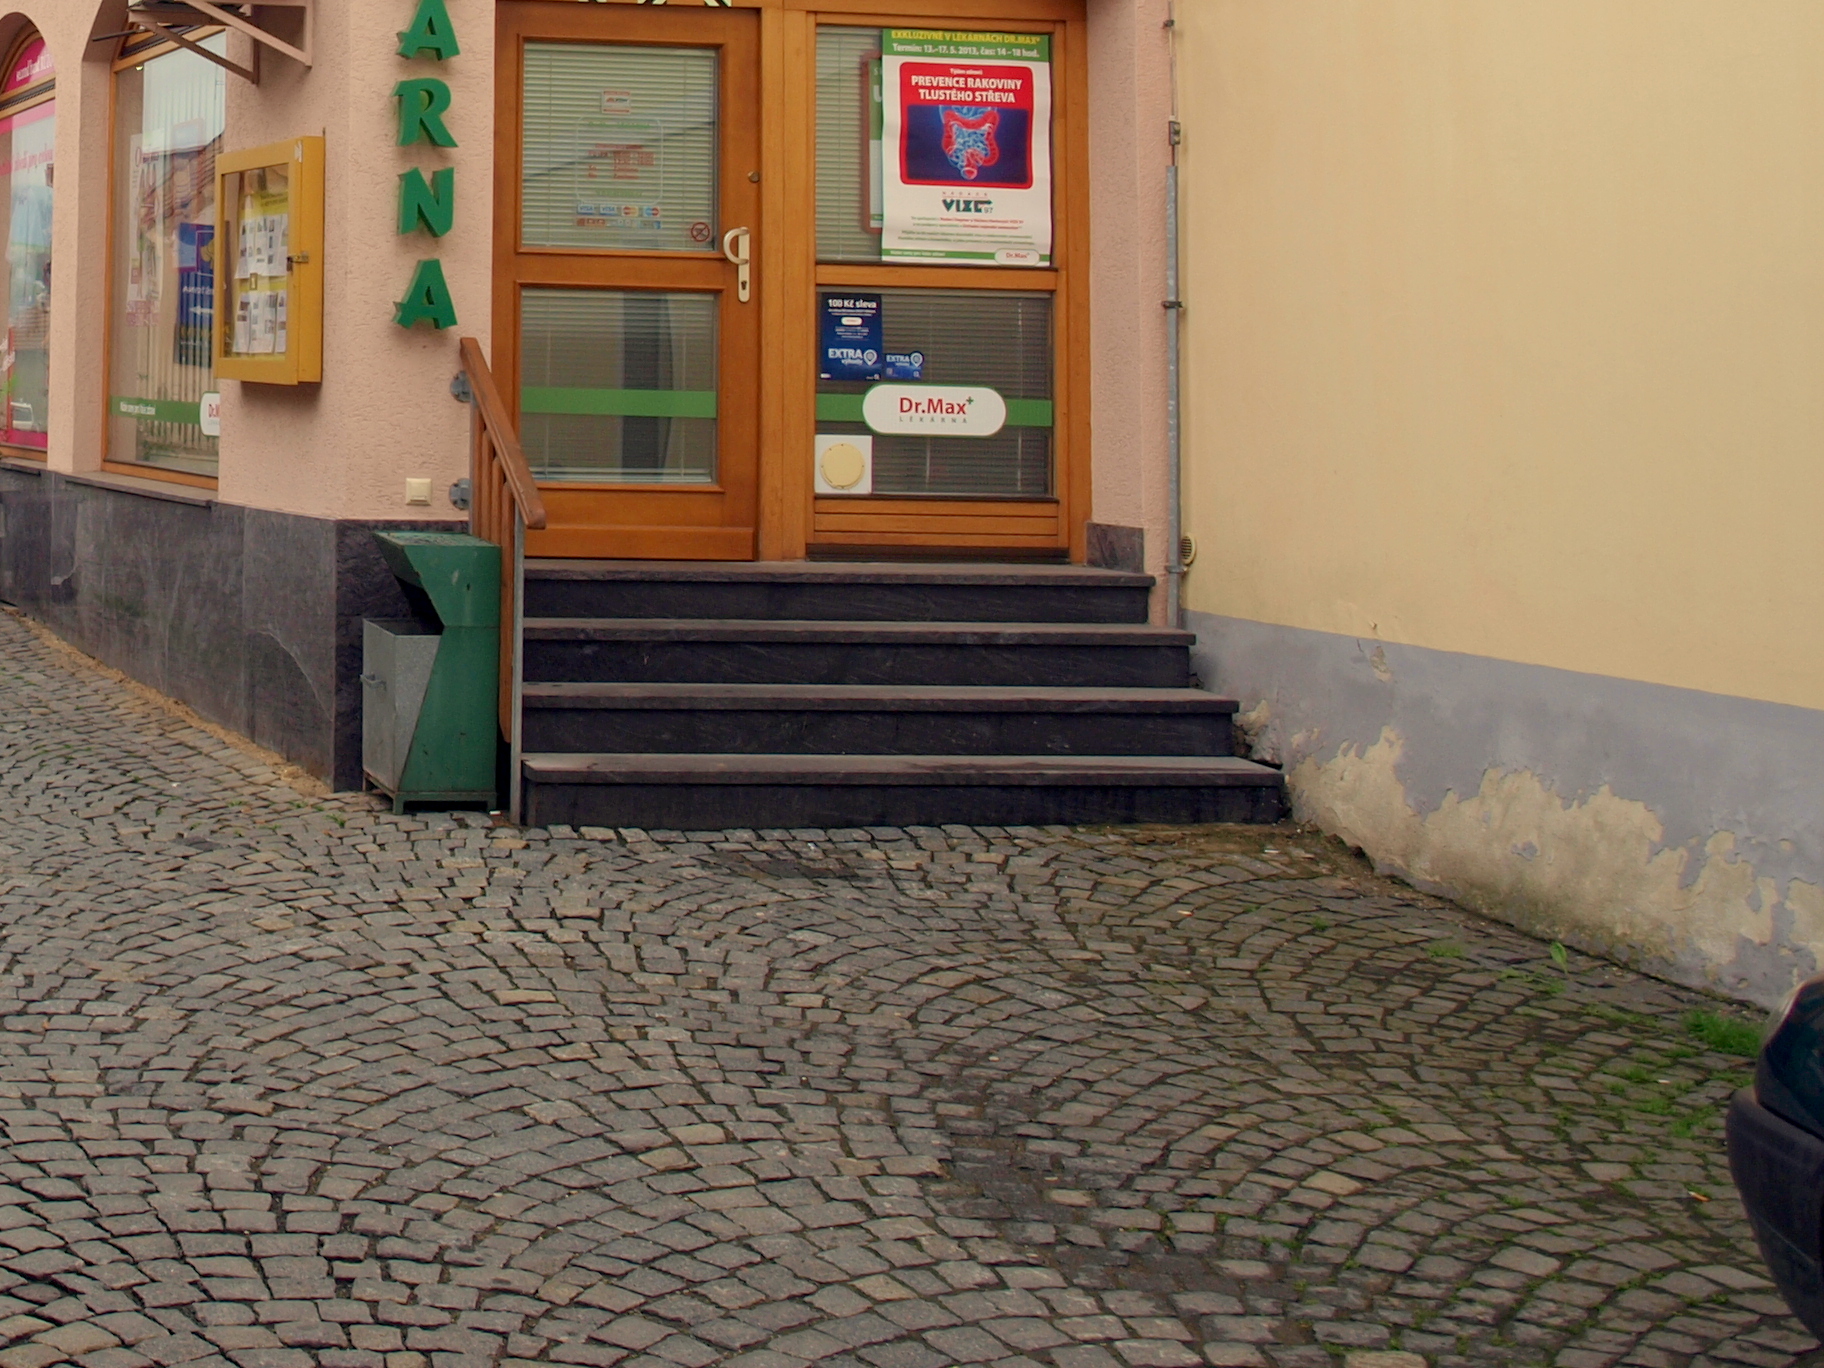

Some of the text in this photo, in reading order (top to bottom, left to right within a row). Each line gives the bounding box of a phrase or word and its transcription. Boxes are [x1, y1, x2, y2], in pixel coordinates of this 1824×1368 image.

[911, 75, 1022, 90] PREVENCE RAKOVINY
[918, 88, 1016, 103] TLUSTÉHO STŘEVA
[828, 348, 863, 359] EXTRA
[886, 354, 911, 363] EXTRA
